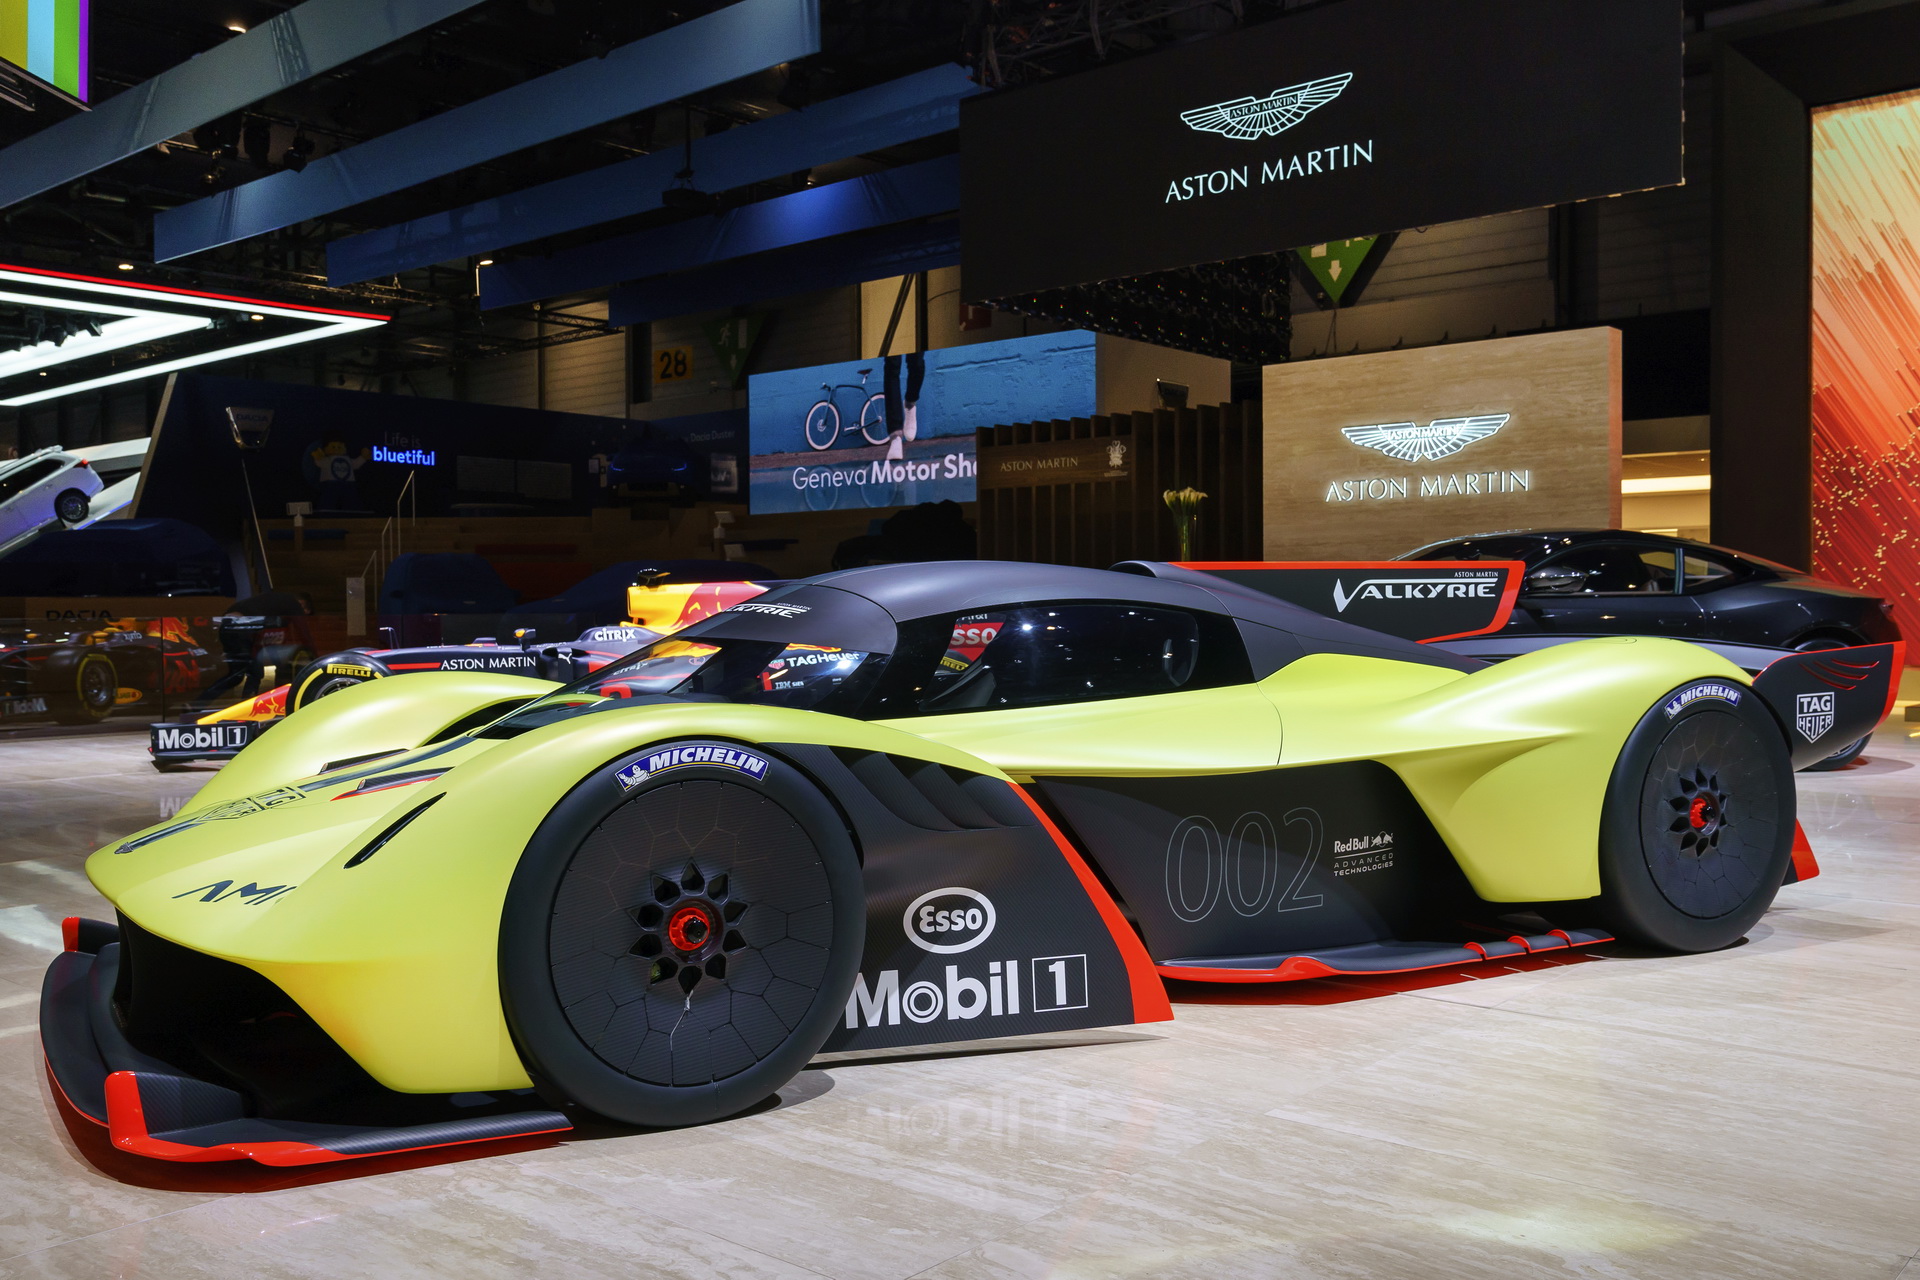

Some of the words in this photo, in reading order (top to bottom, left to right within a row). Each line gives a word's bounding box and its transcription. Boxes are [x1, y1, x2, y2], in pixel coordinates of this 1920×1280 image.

[1230, 104, 1260, 119] ASTON
[1262, 95, 1297, 112] MARTIN
[1165, 165, 1248, 203] ASTON
[1261, 139, 1372, 184] MARTIN
[660, 350, 686, 378] 28
[384, 431, 409, 447] Life
[411, 434, 422, 447] is
[1390, 428, 1421, 440] ASTON
[1421, 424, 1458, 439] MARTIN
[372, 445, 436, 466] bluetiful
[1000, 460, 1033, 472] ASTON
[1036, 456, 1078, 470] MARTIN
[793, 467, 866, 490] Geneva
[871, 460, 940, 484] Motor
[1325, 477, 1408, 502] ASTON
[1420, 470, 1530, 497] MARTIN
[1333, 578, 1498, 613] VALKYRIE
[46, 609, 112, 621] DACIA
[950, 627, 998, 646] SSO
[326, 663, 372, 678] PIRELLI
[441, 658, 485, 671] ASTON
[489, 656, 536, 669] MARTIN
[1680, 685, 1739, 704] MICHELIN
[1800, 695, 1831, 713] TAG
[1799, 714, 1832, 740] HEUER
[158, 727, 224, 750] Mobil
[649, 747, 766, 774] MICHELIN
[1334, 838, 1352, 854] Red
[1352, 836, 1369, 851] Bull
[1165, 806, 1324, 922] 002
[1333, 860, 1394, 877] TECHNOLOGIES
[1334, 852, 1394, 869] ADVANCED
[172, 879, 298, 906] AM
[919, 905, 983, 934] Esso
[845, 959, 1020, 1030] Mobil
